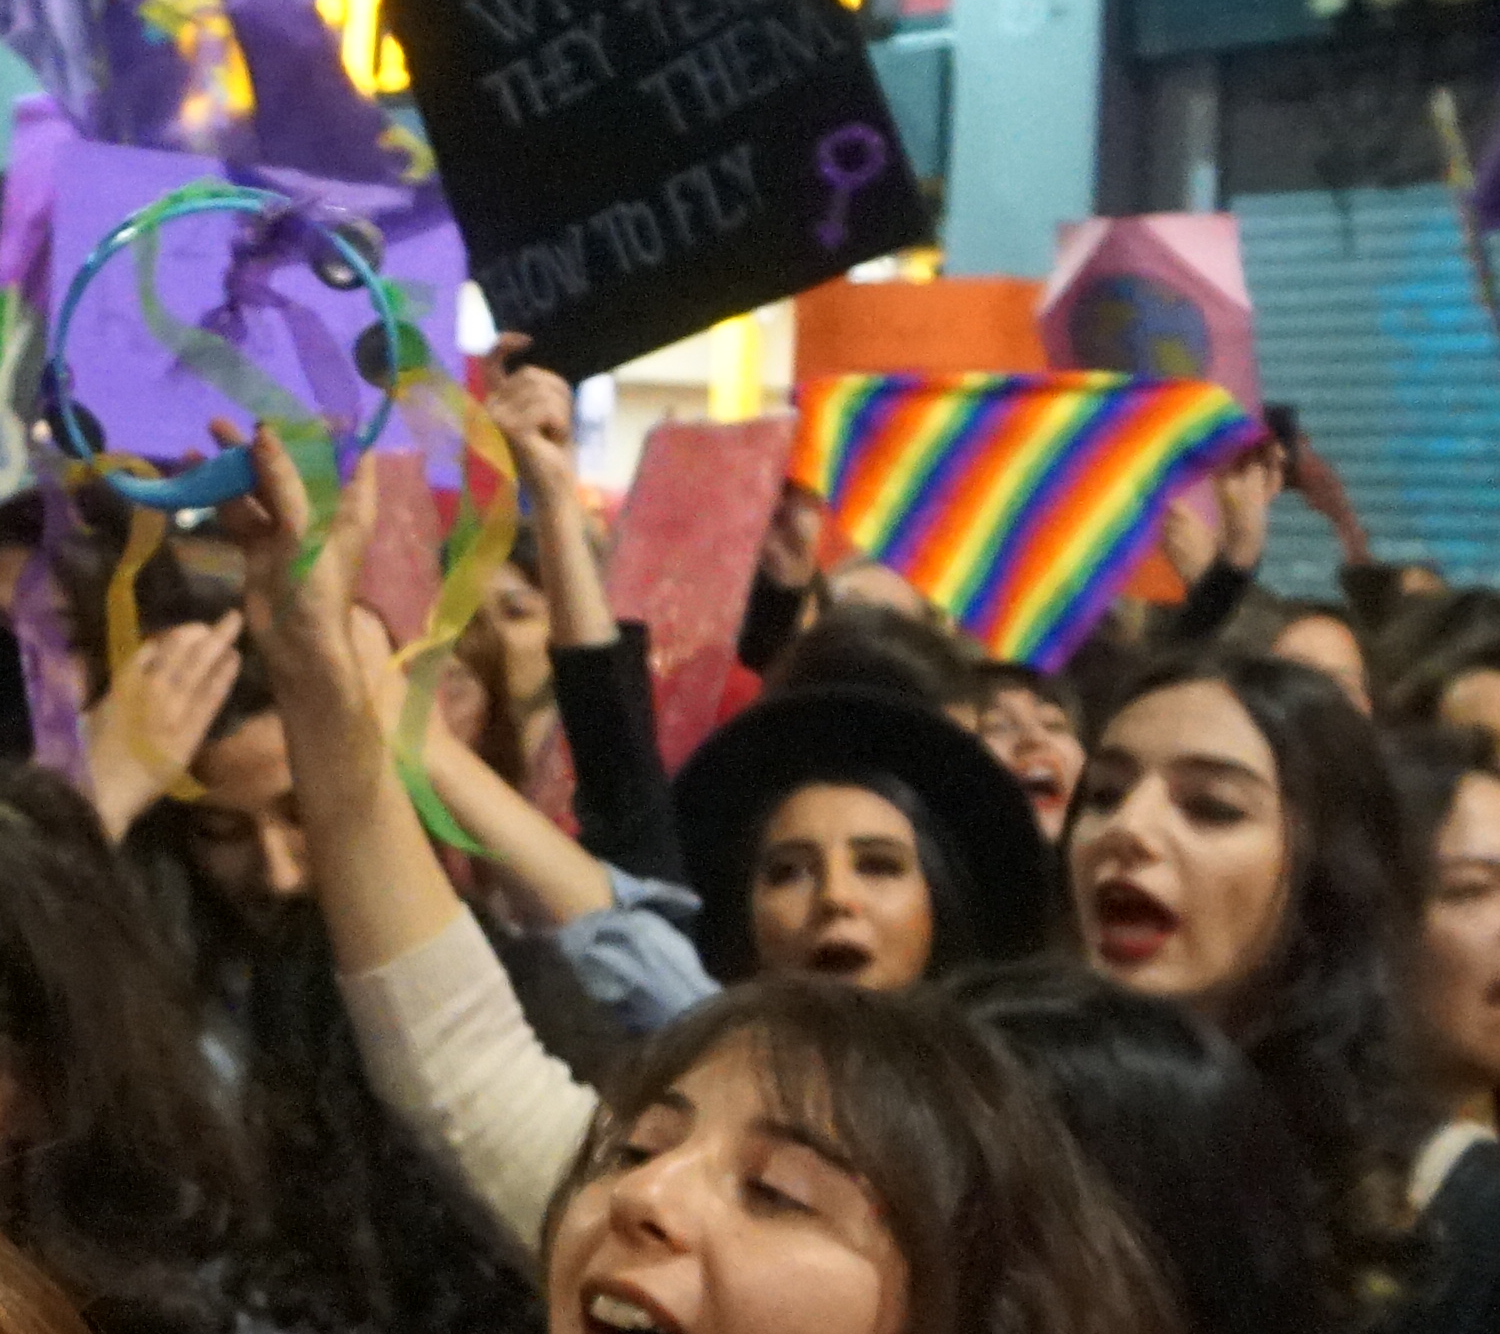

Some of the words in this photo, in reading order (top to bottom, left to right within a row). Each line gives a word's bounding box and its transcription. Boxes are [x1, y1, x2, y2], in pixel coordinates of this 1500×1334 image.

[482, 14, 613, 122] THEY
[479, 225, 588, 328] HOW
[592, 201, 664, 271] TO
[663, 143, 761, 244] FLY
